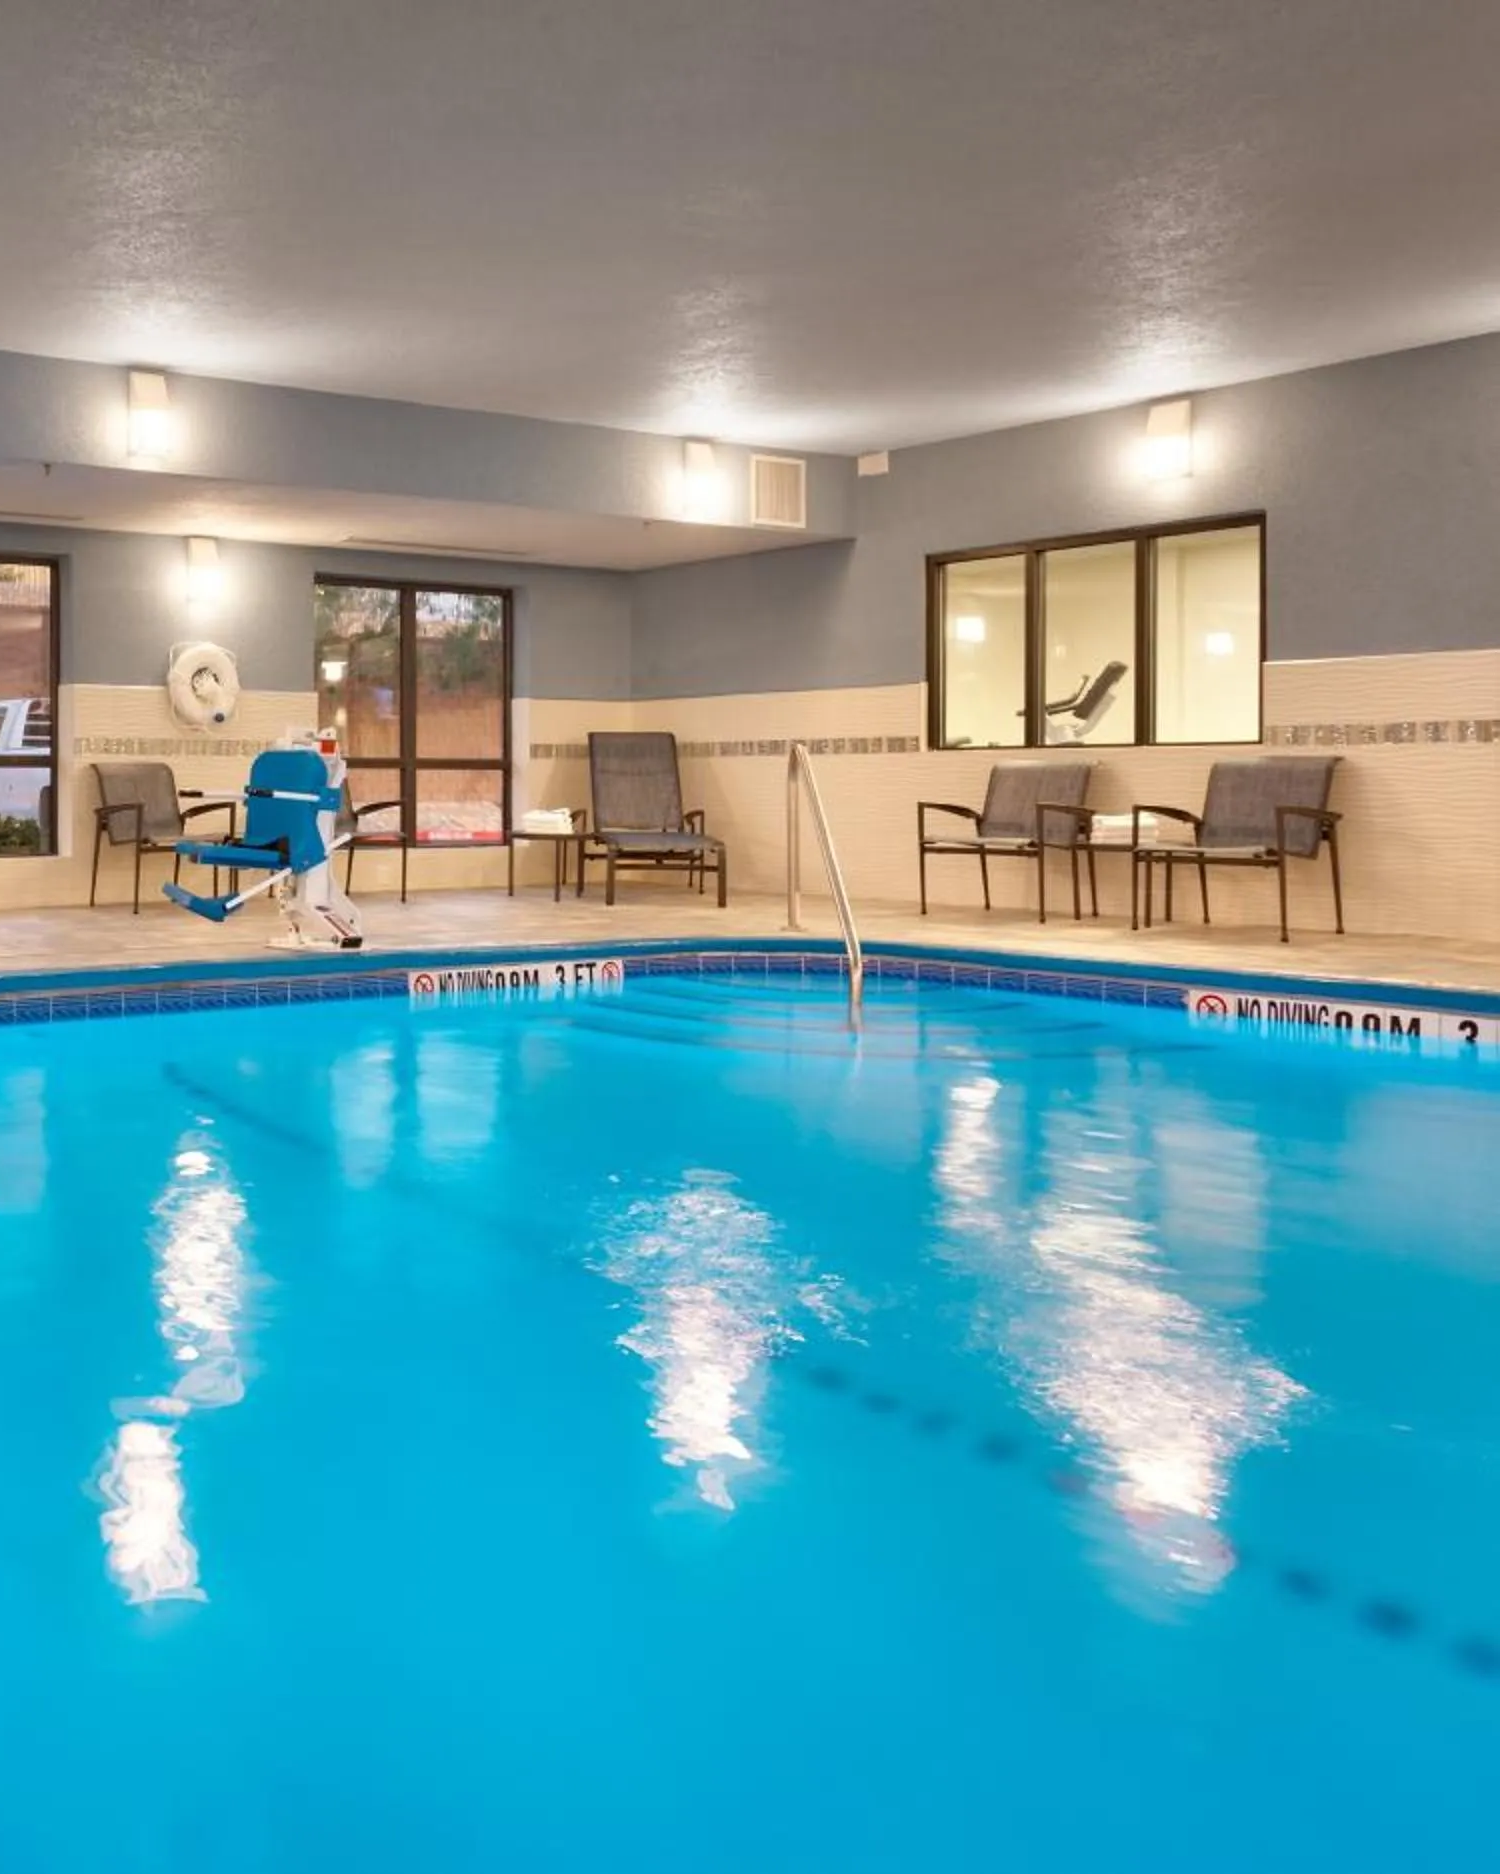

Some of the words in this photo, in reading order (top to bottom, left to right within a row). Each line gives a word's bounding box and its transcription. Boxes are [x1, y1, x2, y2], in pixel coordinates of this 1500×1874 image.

[574, 962, 597, 987] FT
[1237, 998, 1261, 1019] NO
[1267, 1001, 1329, 1028] DIVING
